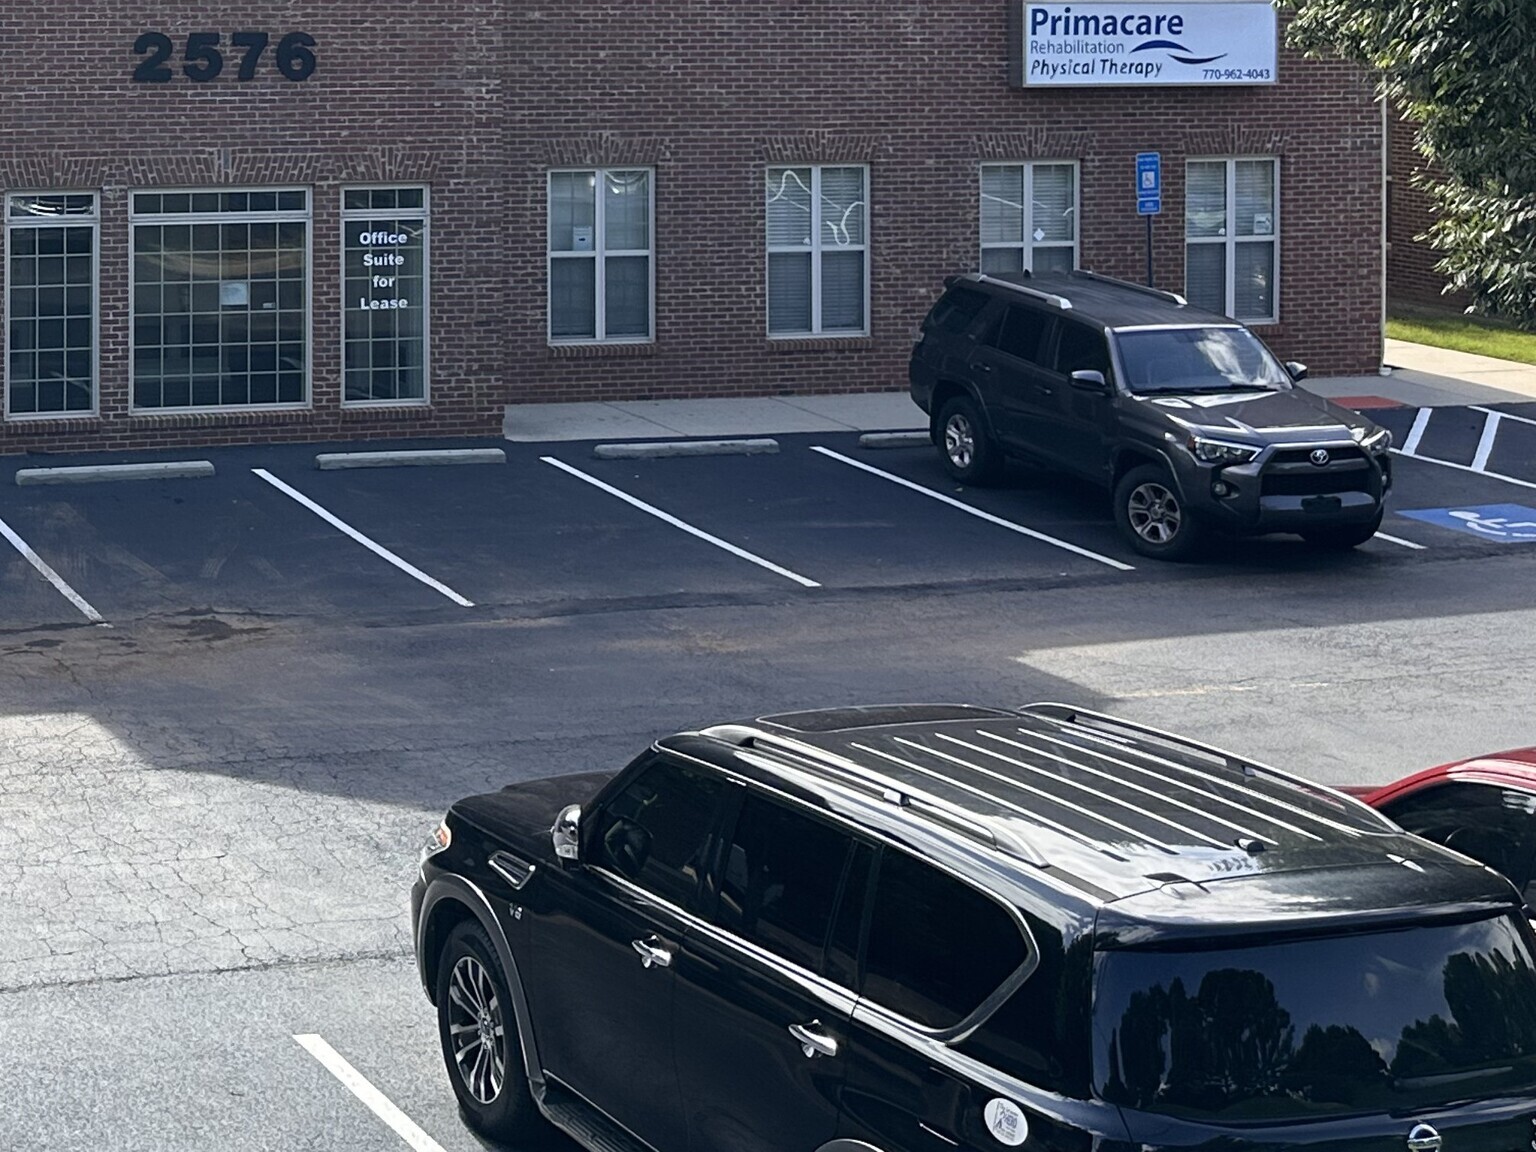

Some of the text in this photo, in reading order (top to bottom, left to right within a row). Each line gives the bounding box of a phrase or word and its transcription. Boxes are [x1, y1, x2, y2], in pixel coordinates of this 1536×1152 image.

[1031, 7, 1183, 35] Primacare
[1030, 40, 1124, 54] Rehabilitation
[133, 32, 317, 82] 2576
[1031, 59, 1162, 78] Physical Therapy
[1202, 69, 1270, 79] 770-962-4043
[359, 232, 408, 245] Office
[364, 253, 404, 266] Suite
[373, 275, 395, 288] for
[360, 297, 408, 309] Lease
